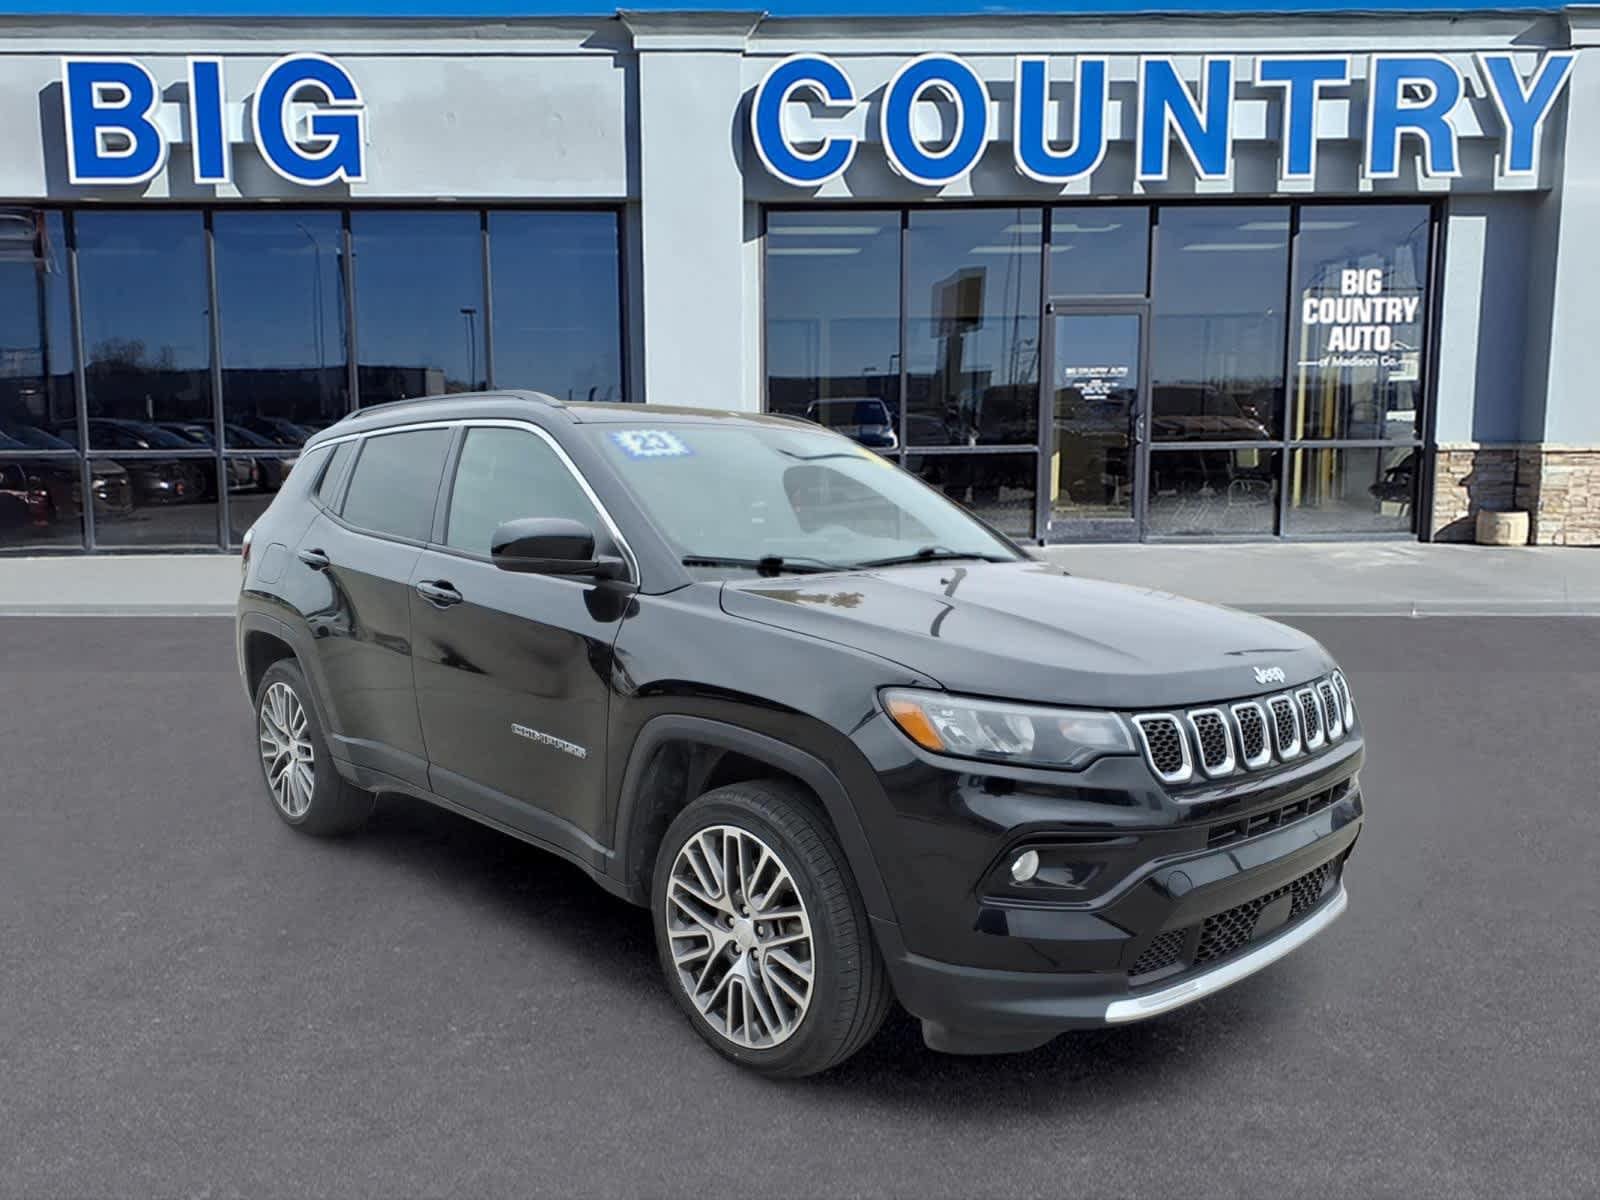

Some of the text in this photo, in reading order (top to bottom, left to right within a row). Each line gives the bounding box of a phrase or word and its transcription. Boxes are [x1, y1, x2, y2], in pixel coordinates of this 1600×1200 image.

[61, 50, 1578, 188] BIG COUNTRY
[1340, 268, 1383, 296] BIG
[1302, 297, 1420, 325] COUNTRY
[1327, 325, 1392, 352] AUTO
[1319, 355, 1330, 368] of
[1331, 354, 1379, 368] Madison
[1252, 666, 1286, 684] Jeep
